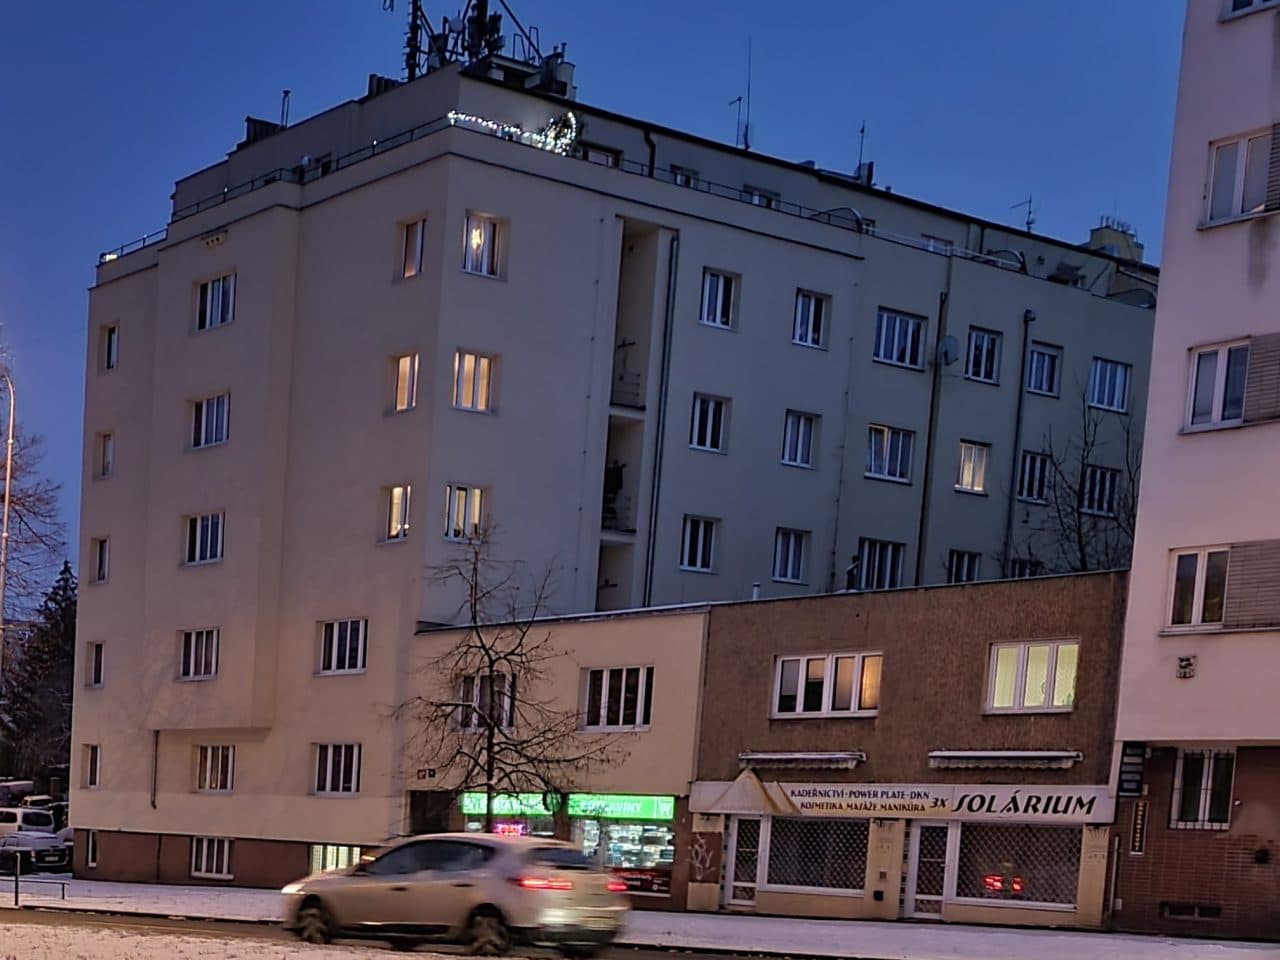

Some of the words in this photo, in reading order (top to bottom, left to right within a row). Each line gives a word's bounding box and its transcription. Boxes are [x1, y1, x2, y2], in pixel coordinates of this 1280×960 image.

[791, 788, 844, 798] KADEŘNICTVÍ
[848, 790, 878, 799] POWER
[800, 801, 843, 810] KOSMETIKA
[847, 801, 876, 811] MASÁŽE
[880, 802, 926, 812] MANIKÚRA
[952, 790, 1096, 814] SOLÁRIUM
